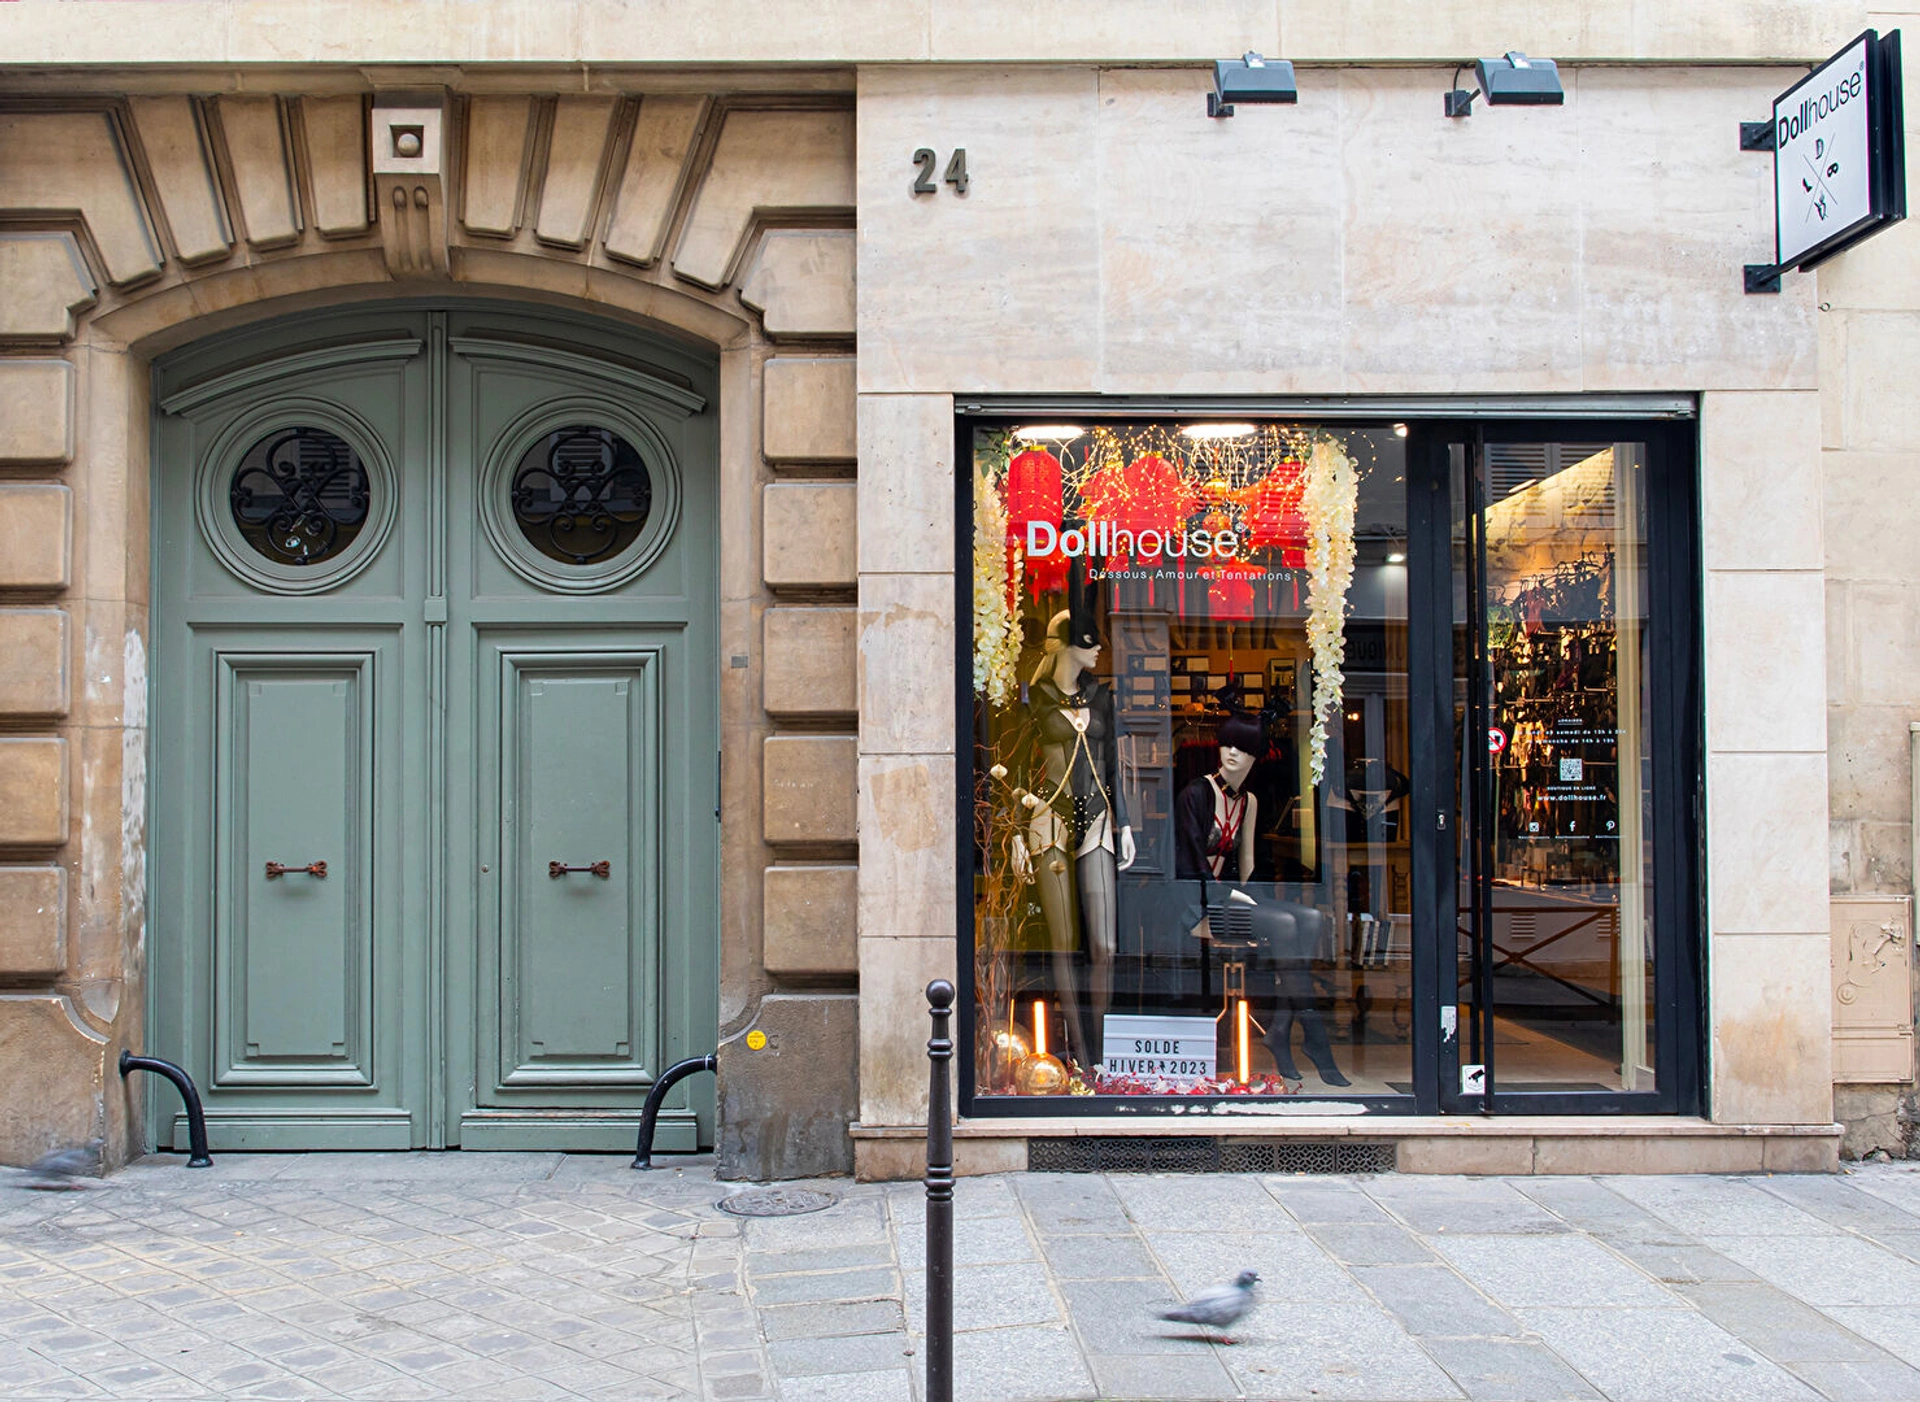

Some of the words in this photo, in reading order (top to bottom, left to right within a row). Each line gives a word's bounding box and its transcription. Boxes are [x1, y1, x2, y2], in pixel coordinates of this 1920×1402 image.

[912, 148, 969, 194] 24
[1155, 569, 1198, 580] Amour
[1202, 570, 1215, 580] et
[1219, 569, 1291, 581] Tentations
[1134, 1039, 1180, 1055] SOLDE
[1109, 1059, 1155, 1074] HIVER
[1170, 1060, 1207, 1075] 2023
